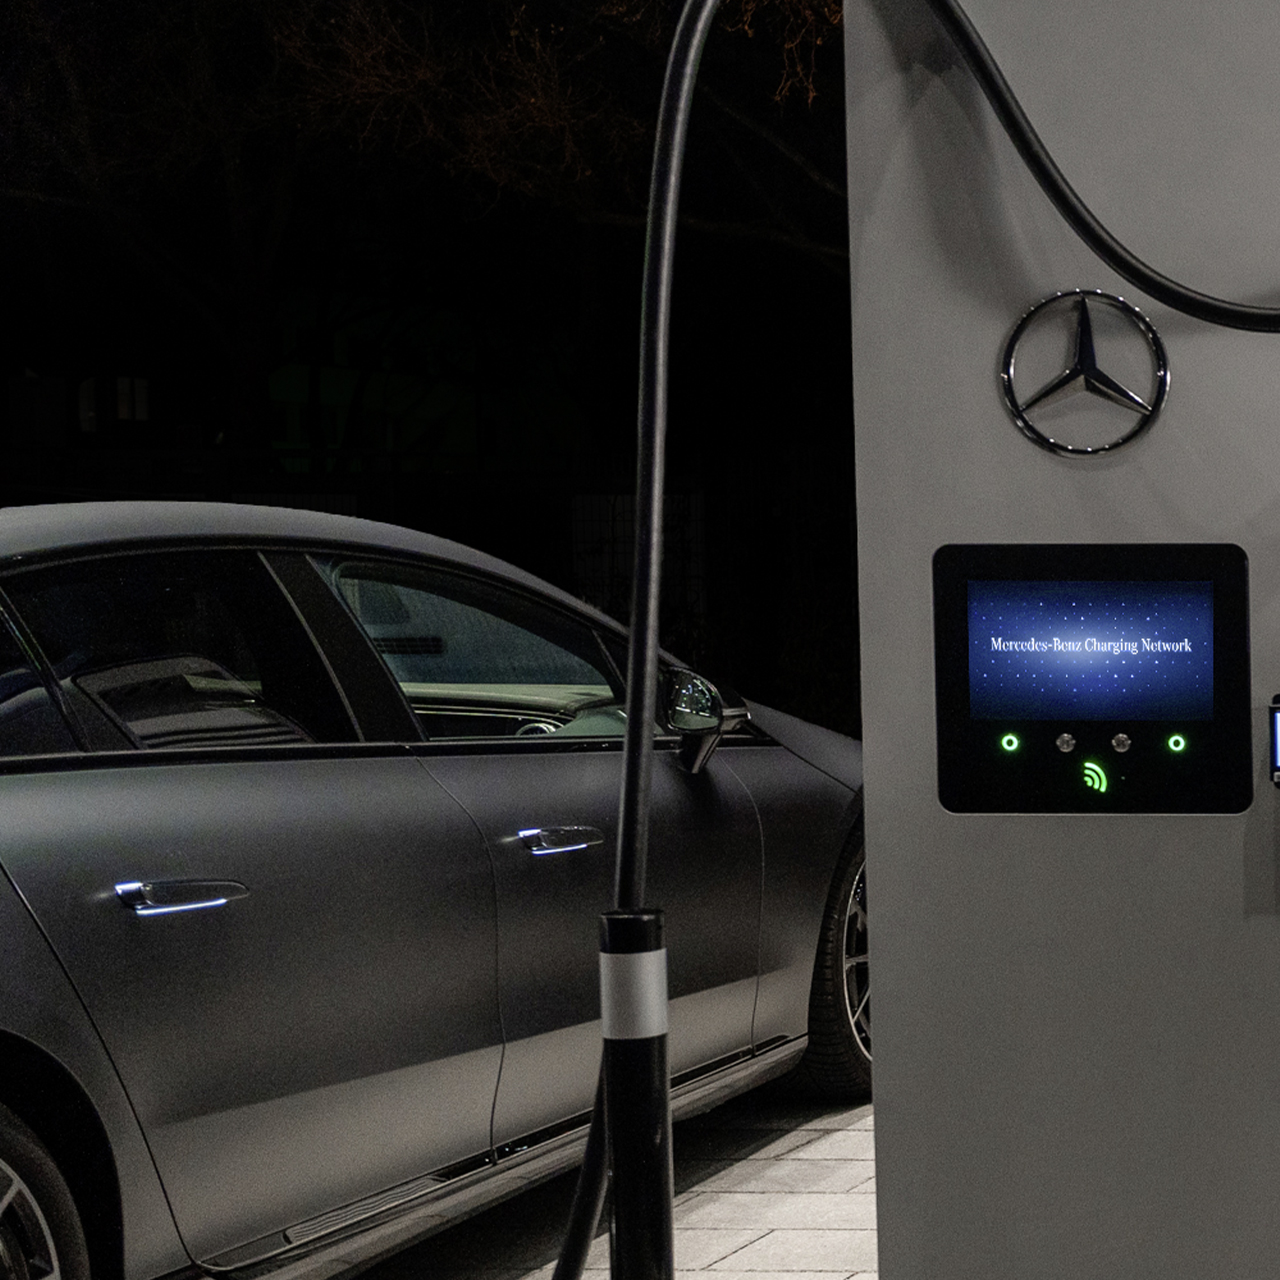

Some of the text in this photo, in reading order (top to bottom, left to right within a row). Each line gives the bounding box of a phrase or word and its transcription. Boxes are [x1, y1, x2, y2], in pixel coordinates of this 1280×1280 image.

[991, 637, 1193, 655] Mercedes-Benz Charging Network
